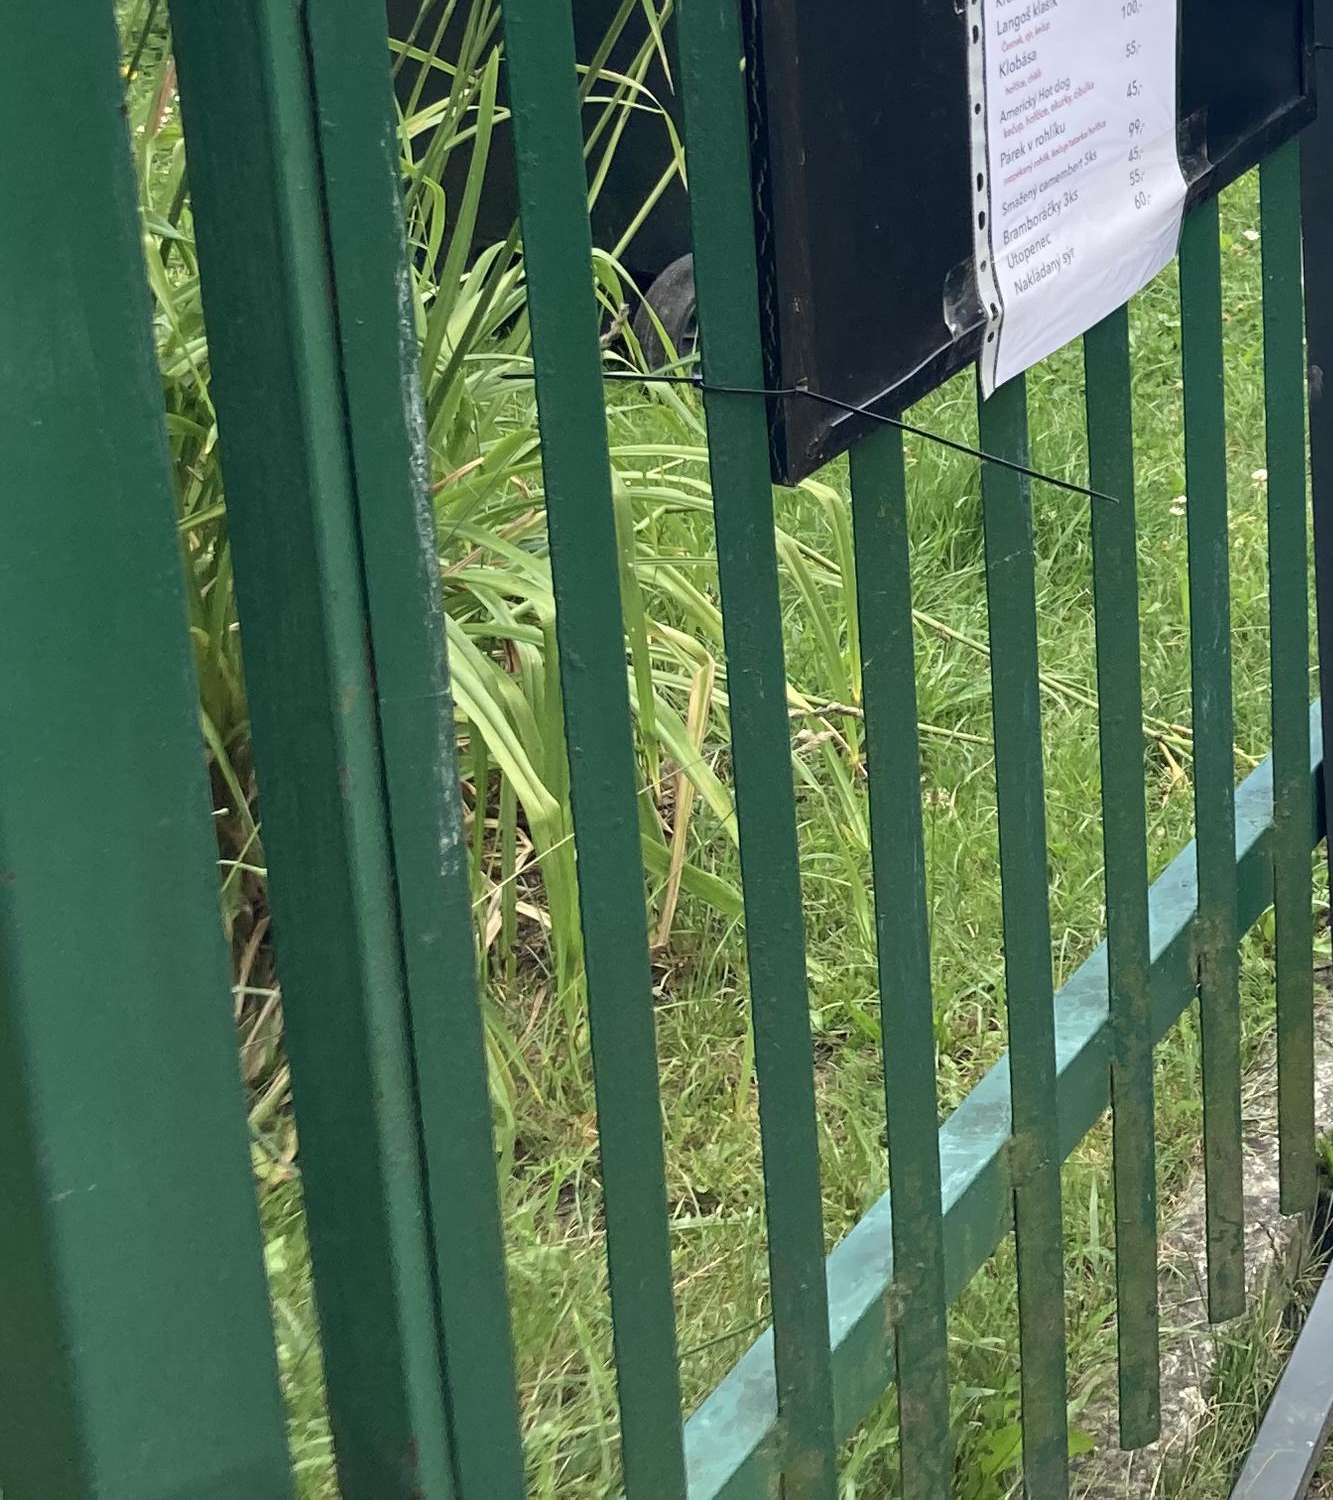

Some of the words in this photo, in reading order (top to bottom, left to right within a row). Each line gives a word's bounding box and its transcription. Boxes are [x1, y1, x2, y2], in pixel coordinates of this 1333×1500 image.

[996, 9, 1031, 36] Langoš
[999, 49, 1037, 79] Klobása
[1038, 83, 1053, 104] Hot
[1054, 76, 1071, 96] dog
[1000, 141, 1026, 169] Párek
[1006, 230, 1053, 270] Utopenec
[1014, 257, 1061, 297] Nakládaný
[1062, 246, 1076, 270] sýr
